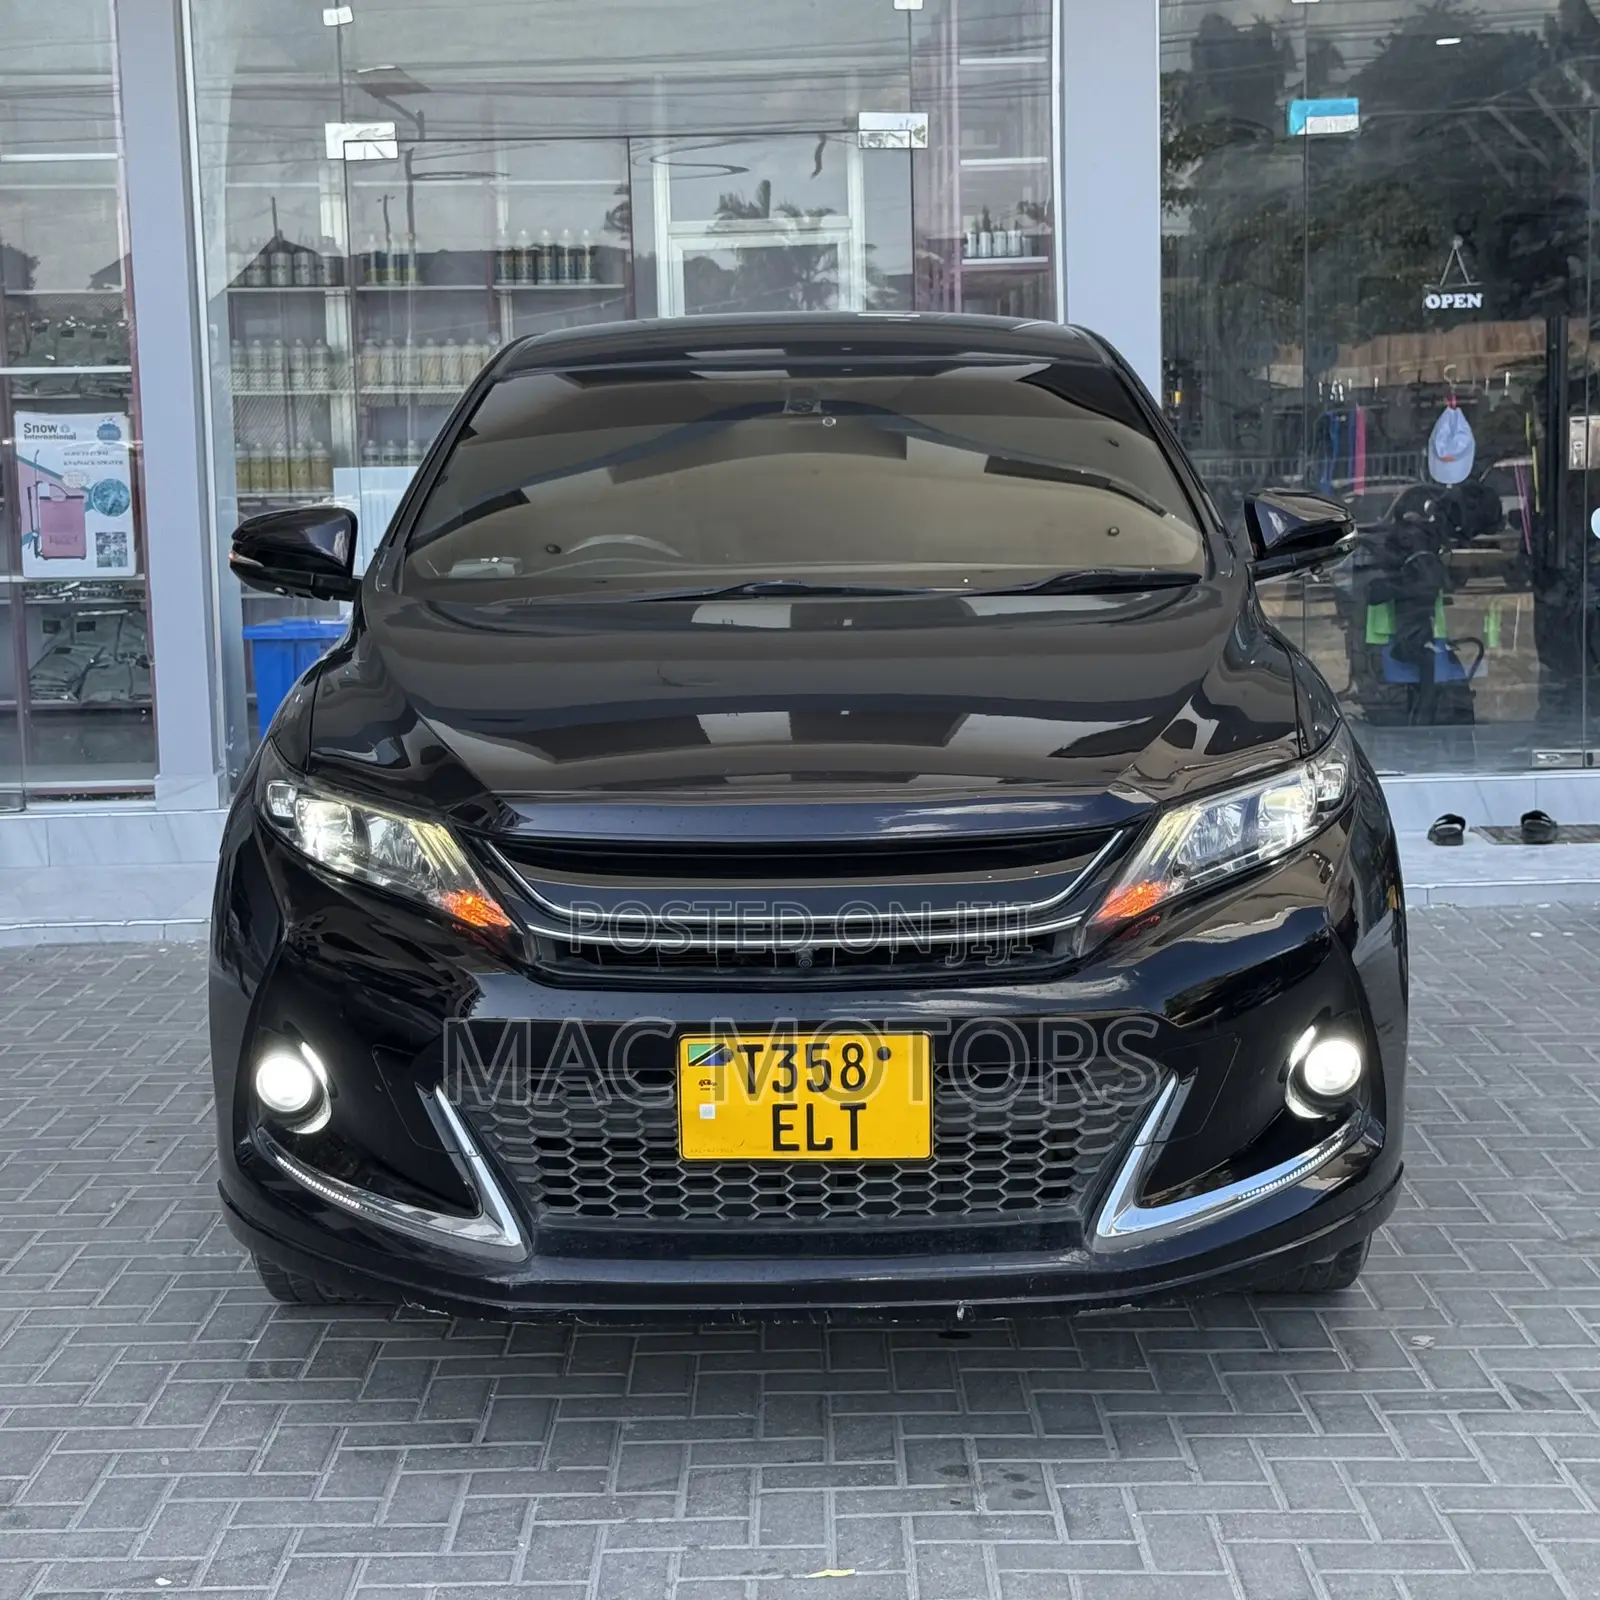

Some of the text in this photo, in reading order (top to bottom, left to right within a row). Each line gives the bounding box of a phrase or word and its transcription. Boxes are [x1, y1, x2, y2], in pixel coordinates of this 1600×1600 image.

[1425, 293, 1483, 309] OPEN
[24, 422, 58, 434] Snow
[737, 1043, 867, 1094] T358
[772, 1103, 867, 1151] ELT
